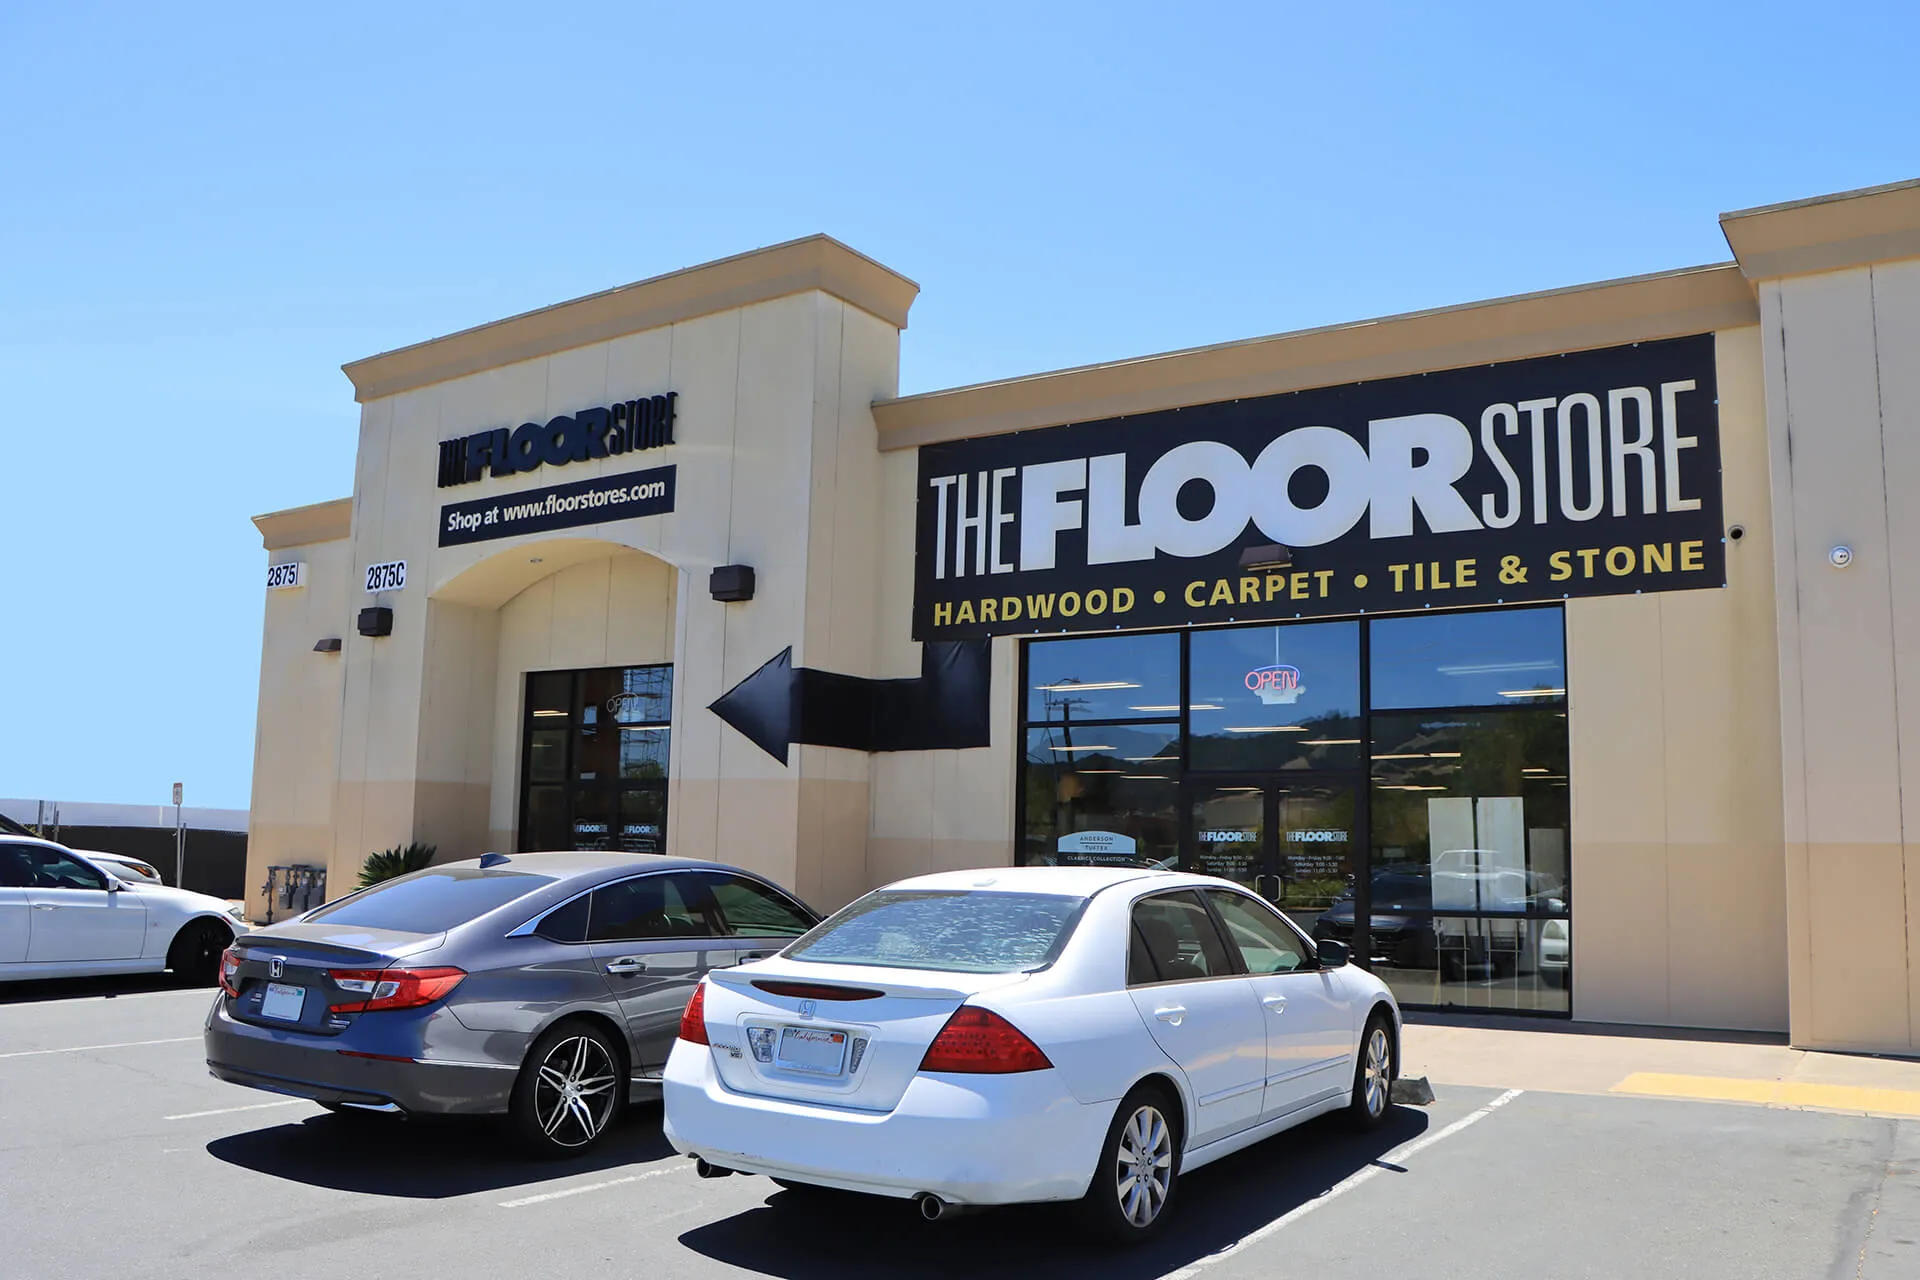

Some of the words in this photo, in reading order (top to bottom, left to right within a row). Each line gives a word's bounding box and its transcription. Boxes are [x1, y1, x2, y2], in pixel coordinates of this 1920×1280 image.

[466, 407, 610, 482] FLOOR
[610, 392, 678, 455] STORE
[930, 467, 1016, 579] THE
[1020, 413, 1485, 571] FLOOR
[1481, 379, 1701, 529] STORE
[448, 511, 481, 531] Shop
[484, 506, 499, 524] at
[503, 480, 665, 521] www.floorstores.com
[367, 562, 404, 590] 2875C
[934, 587, 1135, 626] HARDWOOD
[1184, 570, 1334, 608] CARPET
[1388, 558, 1478, 592] TILE
[1498, 555, 1528, 584] &
[1549, 540, 1704, 581] STONE
[1245, 671, 1297, 690] OPEN
[579, 824, 600, 833] FLOOR
[628, 825, 650, 834] FLOOR
[1207, 831, 1242, 841] FLOOR
[1295, 831, 1333, 841] FLOOR
